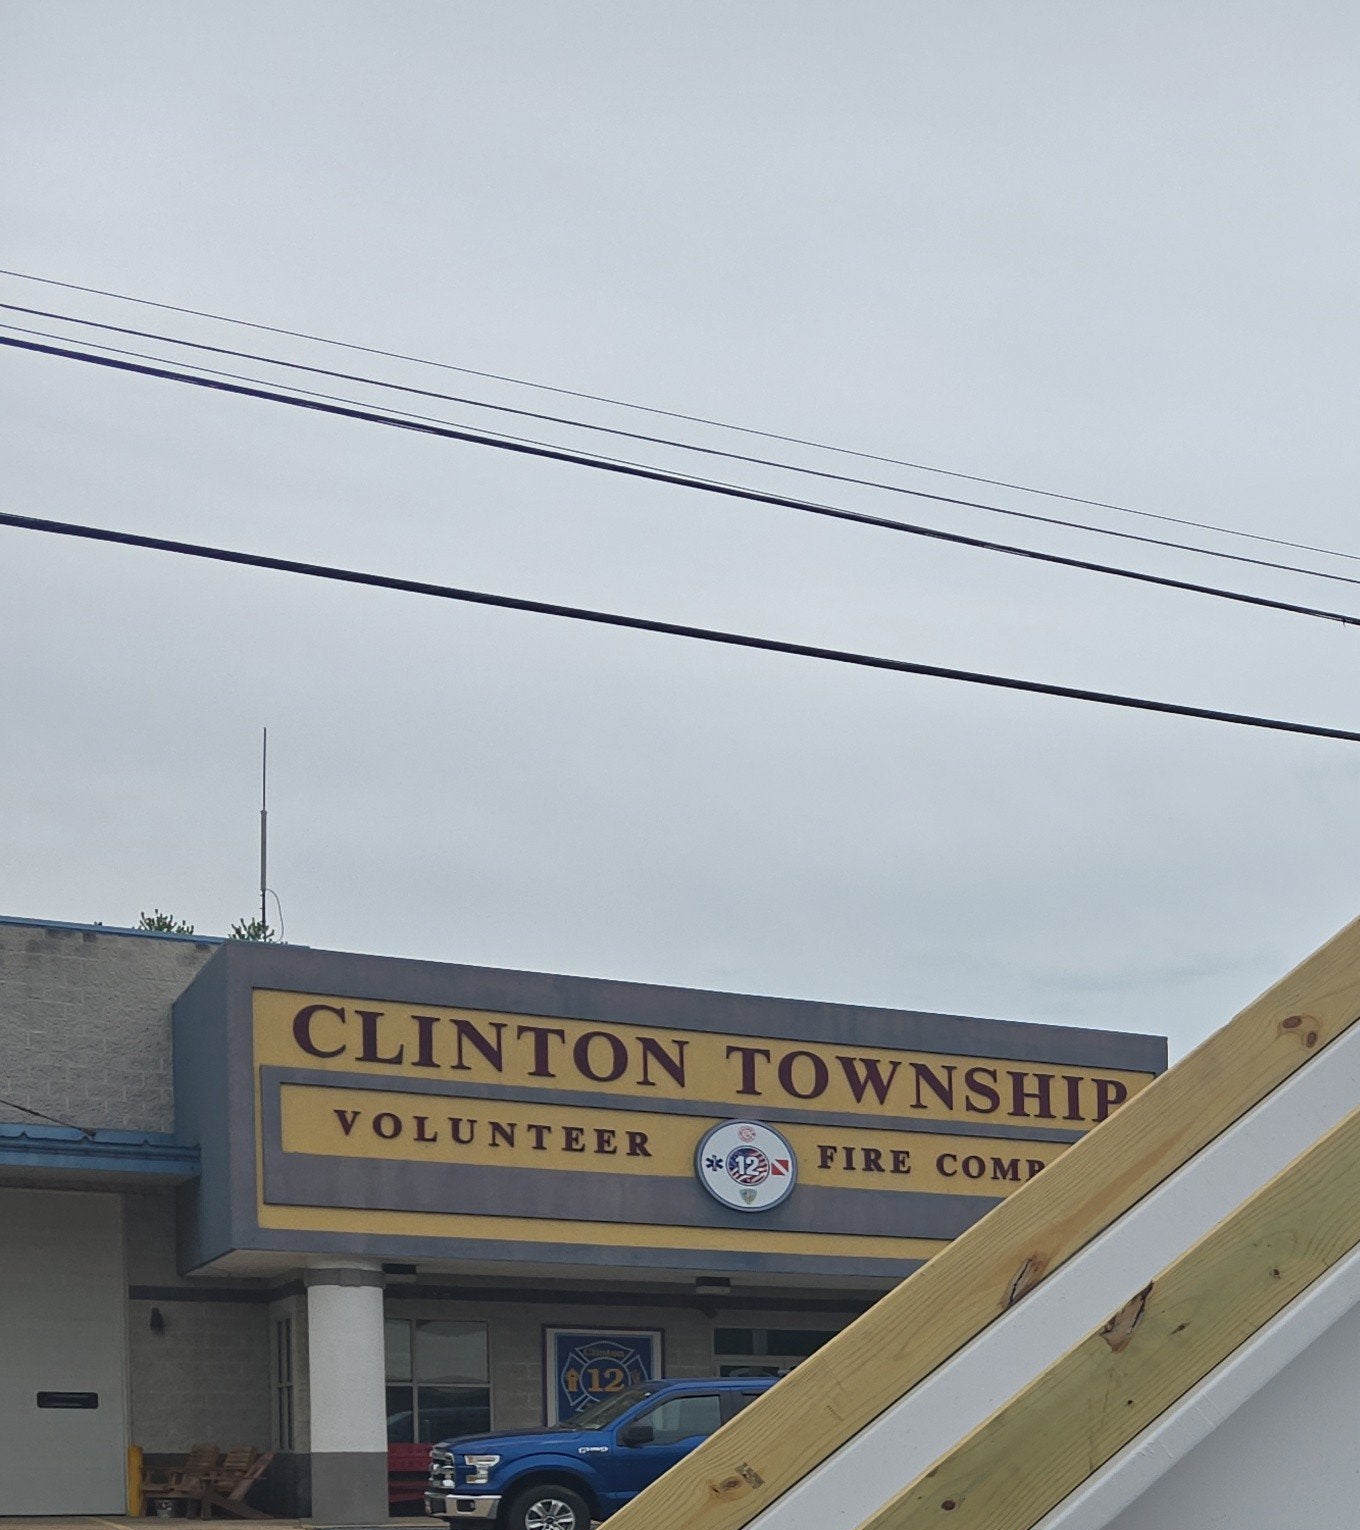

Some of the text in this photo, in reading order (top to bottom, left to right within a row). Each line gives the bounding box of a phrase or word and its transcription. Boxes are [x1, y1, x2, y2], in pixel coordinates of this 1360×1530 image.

[292, 1004, 1128, 1122] CLINTON TOWNSHIP
[333, 1109, 652, 1157] VOLUNTEER
[735, 1155, 760, 1176] 12
[817, 1145, 911, 1174] FIRE
[588, 1368, 624, 1391] 12
